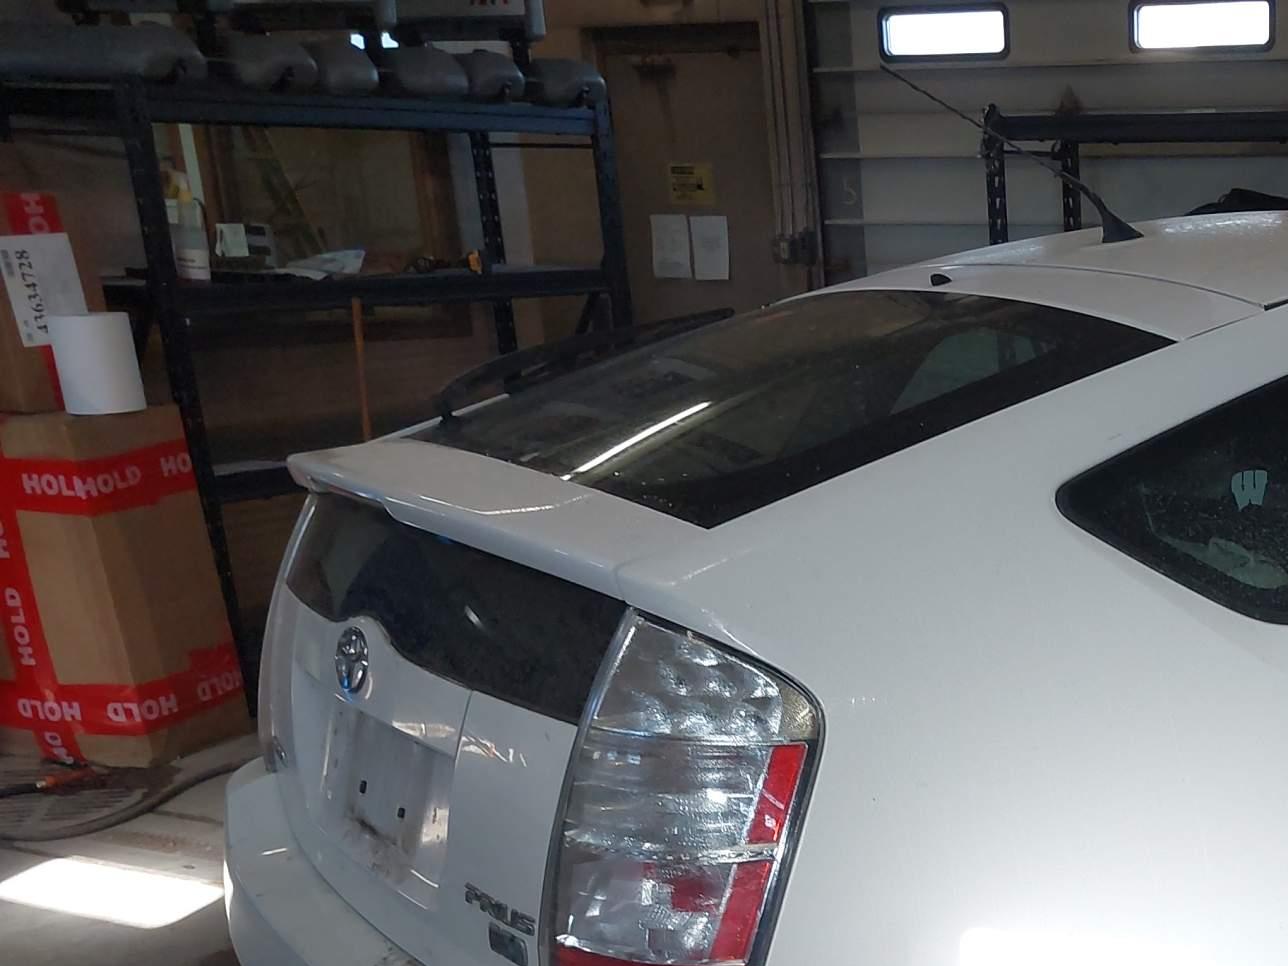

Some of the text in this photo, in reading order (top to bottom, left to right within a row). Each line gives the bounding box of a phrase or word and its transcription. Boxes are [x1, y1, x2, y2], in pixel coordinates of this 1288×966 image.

[20, 193, 50, 234] HO
[159, 453, 192, 478] HO
[21, 473, 76, 497] HOL
[4, 586, 37, 667] HOLD
[17, 698, 82, 722] HOLD
[106, 693, 180, 723] HOLD
